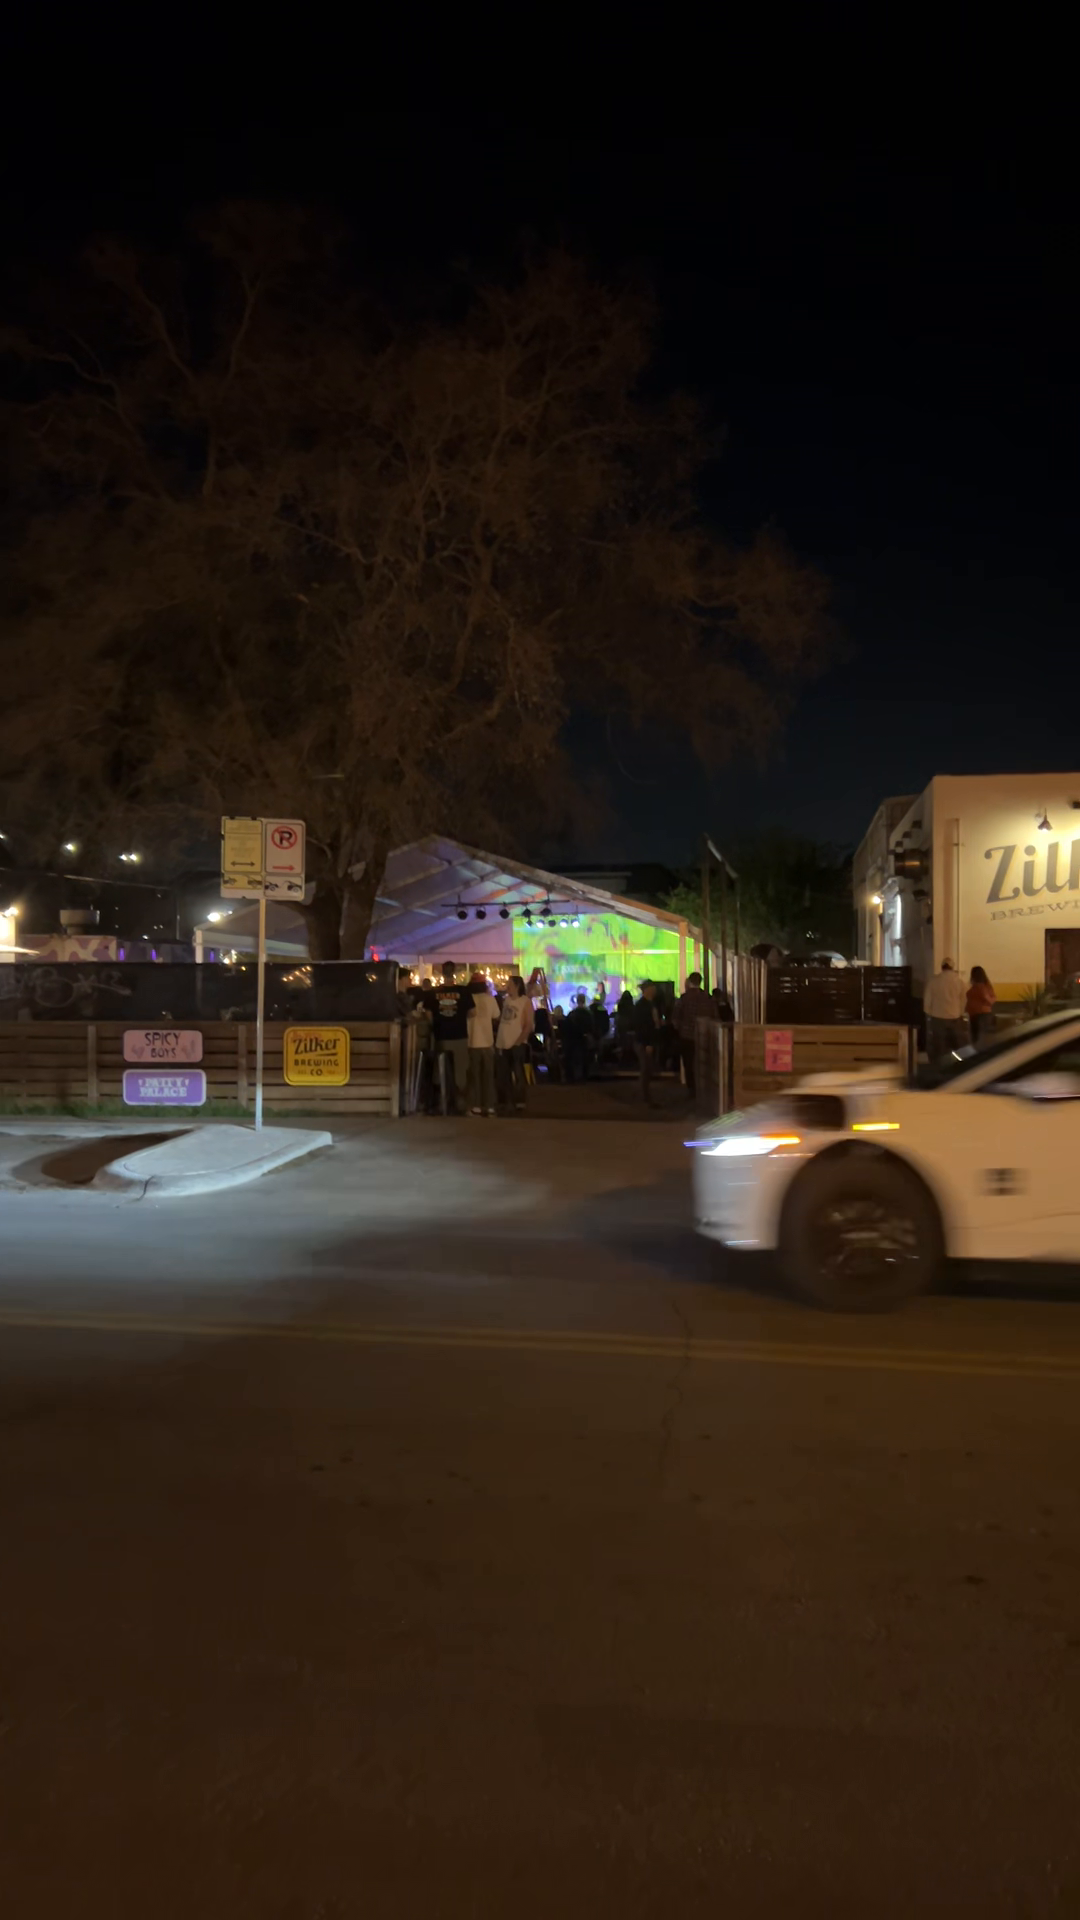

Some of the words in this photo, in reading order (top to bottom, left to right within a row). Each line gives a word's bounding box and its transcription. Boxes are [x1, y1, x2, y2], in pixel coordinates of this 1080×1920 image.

[144, 1031, 181, 1047] SPICY
[293, 1036, 340, 1055] Zilker
[150, 1047, 177, 1059] BOYS
[294, 1058, 340, 1067] BREWING
[145, 1077, 184, 1087] PATTY
[139, 1087, 188, 1097] PALACE
